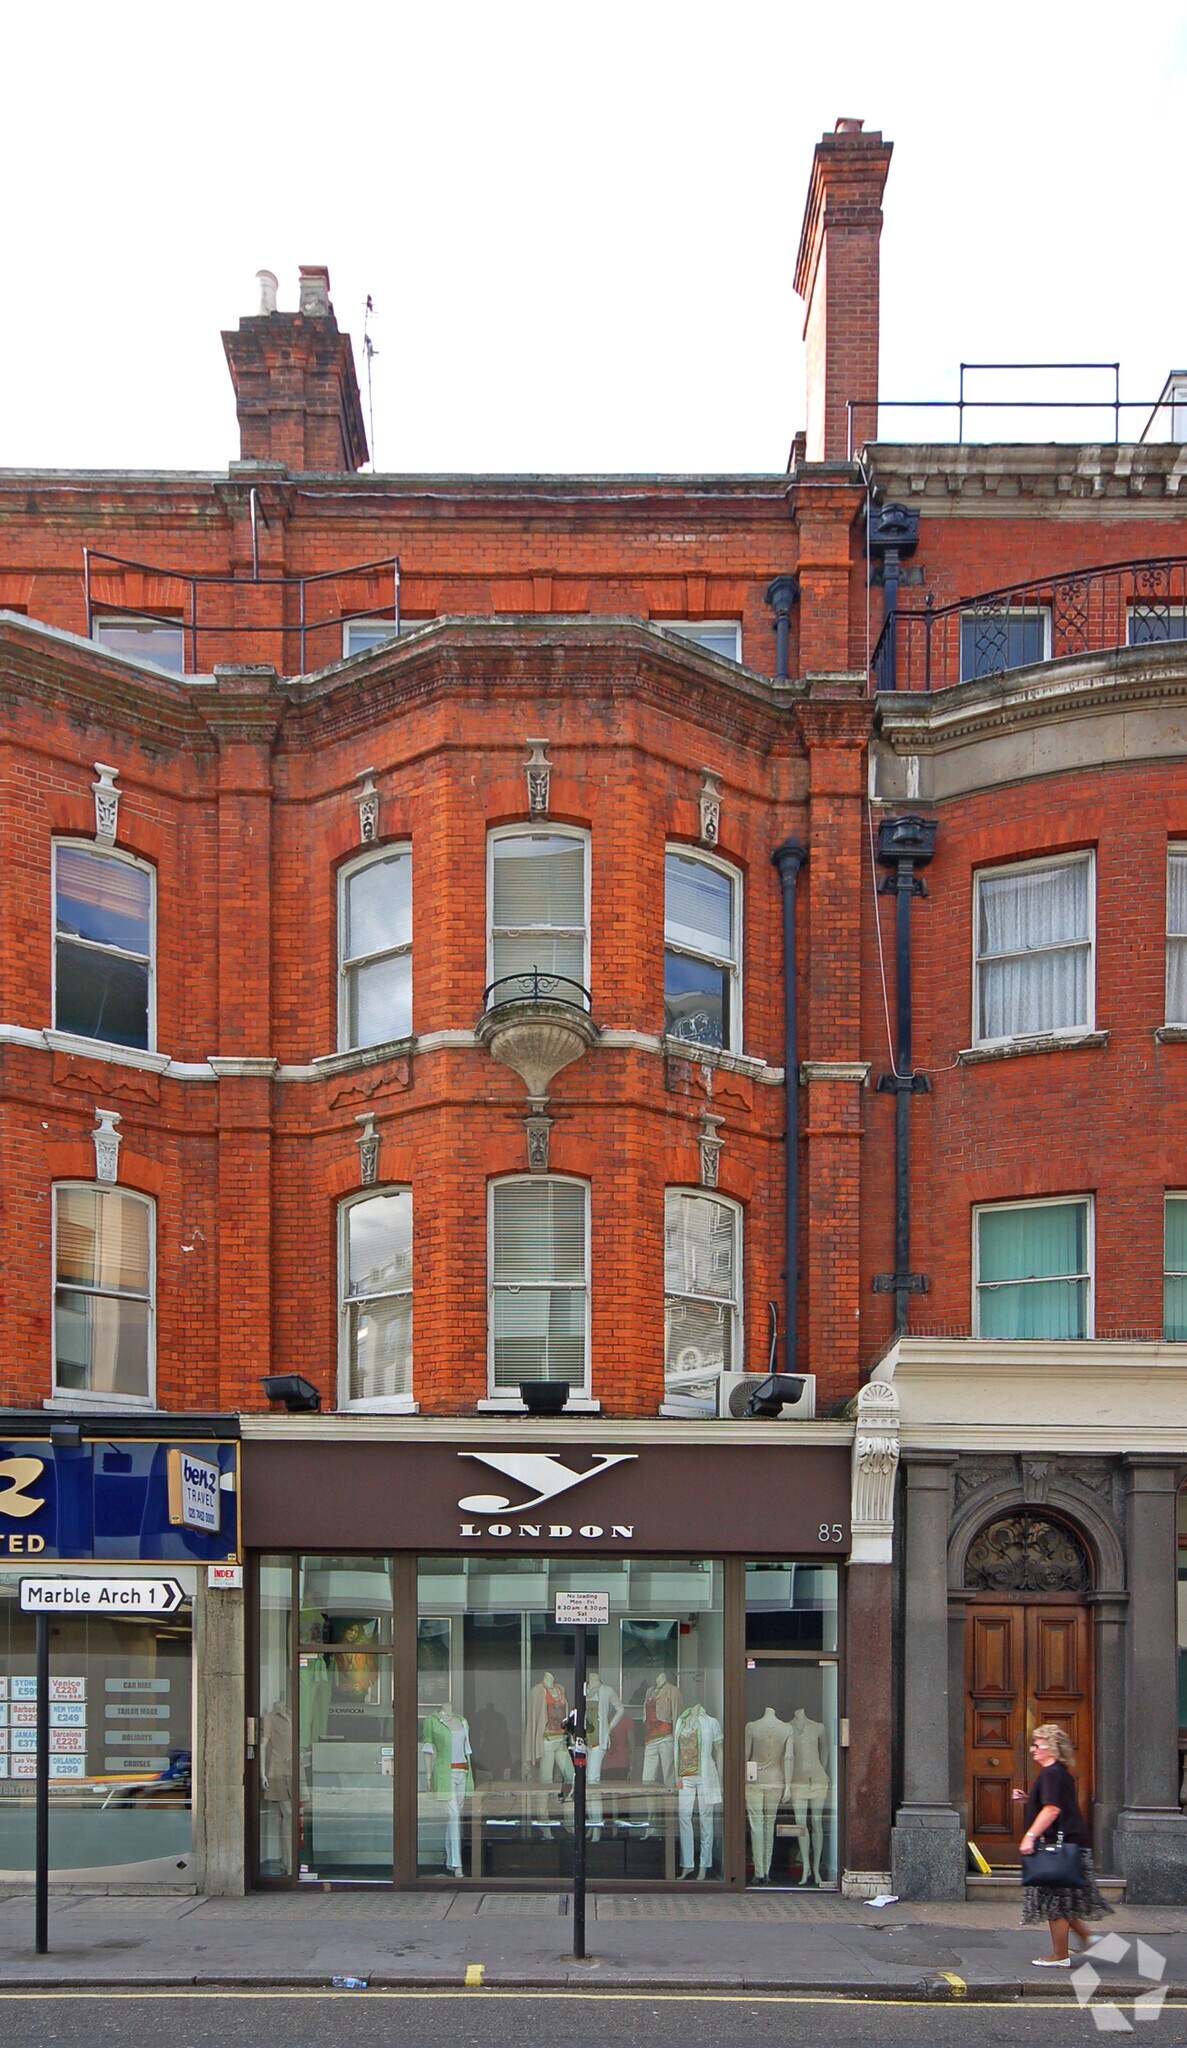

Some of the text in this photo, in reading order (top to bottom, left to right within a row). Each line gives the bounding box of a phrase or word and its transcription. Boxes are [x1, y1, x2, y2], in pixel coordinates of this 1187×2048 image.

[187, 1488, 214, 1507] TRAVEL
[459, 1524, 635, 1538] LONDON
[818, 1524, 843, 1543] 85
[28, 1587, 155, 1604] Marble Arch 1
[57, 1714, 79, 1722] £249
